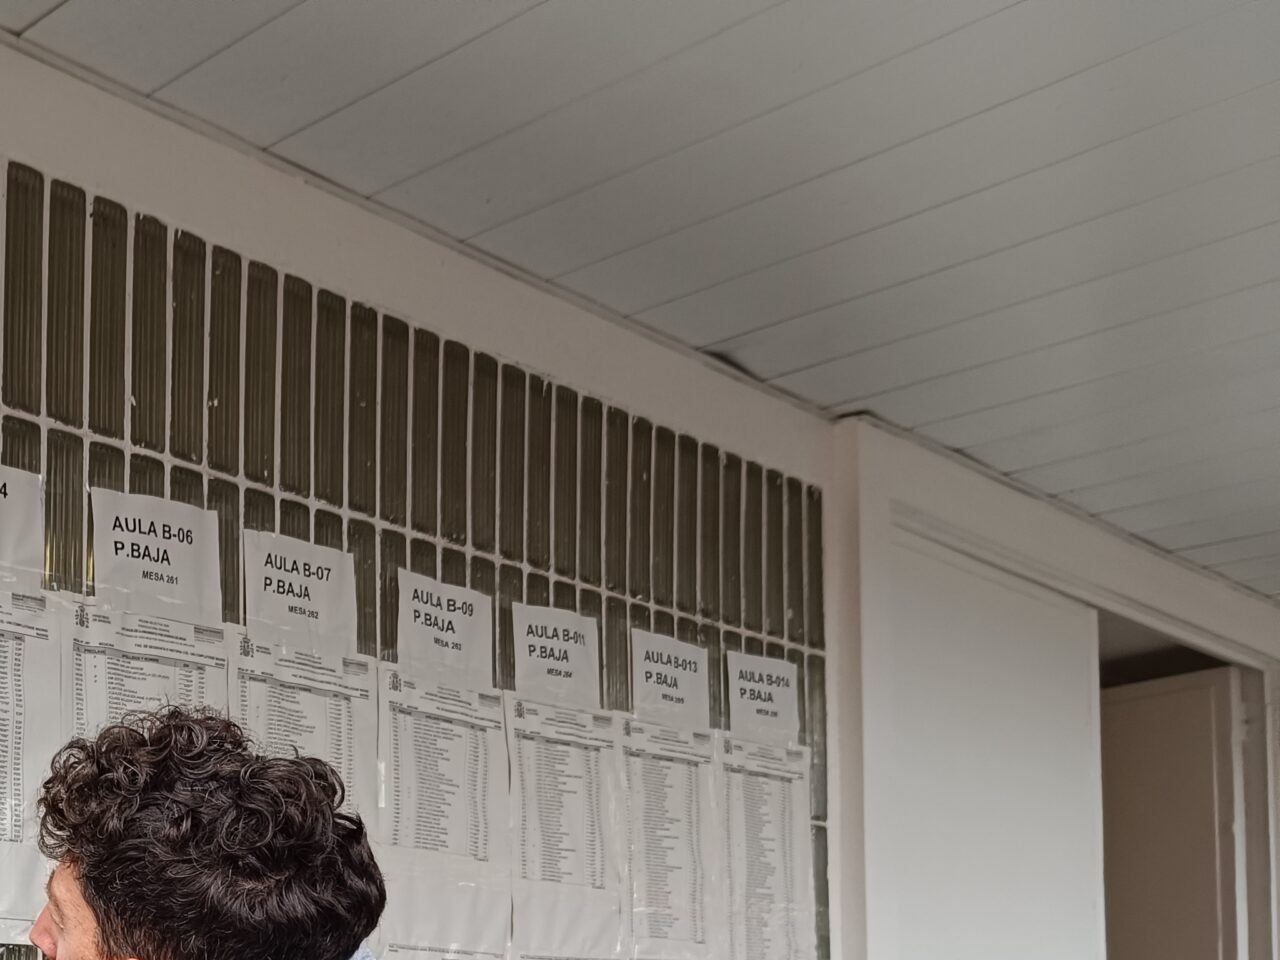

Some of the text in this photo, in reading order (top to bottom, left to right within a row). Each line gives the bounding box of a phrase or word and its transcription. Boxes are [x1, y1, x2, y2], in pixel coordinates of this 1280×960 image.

[112, 515, 194, 545] AULA B-06
[114, 540, 171, 566] P.BAJA
[264, 552, 332, 582] AULA B-07
[142, 570, 179, 585] MESA 261
[263, 578, 311, 601] P.BAJA
[288, 605, 319, 619] MESA 262
[412, 588, 474, 617] AULA B-09
[413, 609, 455, 634] P.BAJA
[434, 637, 449, 648] MESA
[526, 624, 585, 646] AULA B-011
[528, 644, 569, 663] P.BAJA
[644, 650, 698, 673] AULA B-013
[547, 667, 562, 678] MESA
[645, 670, 678, 689] P.BAJA
[738, 669, 790, 688] AULA B-014
[740, 687, 773, 703] P.BAJA
